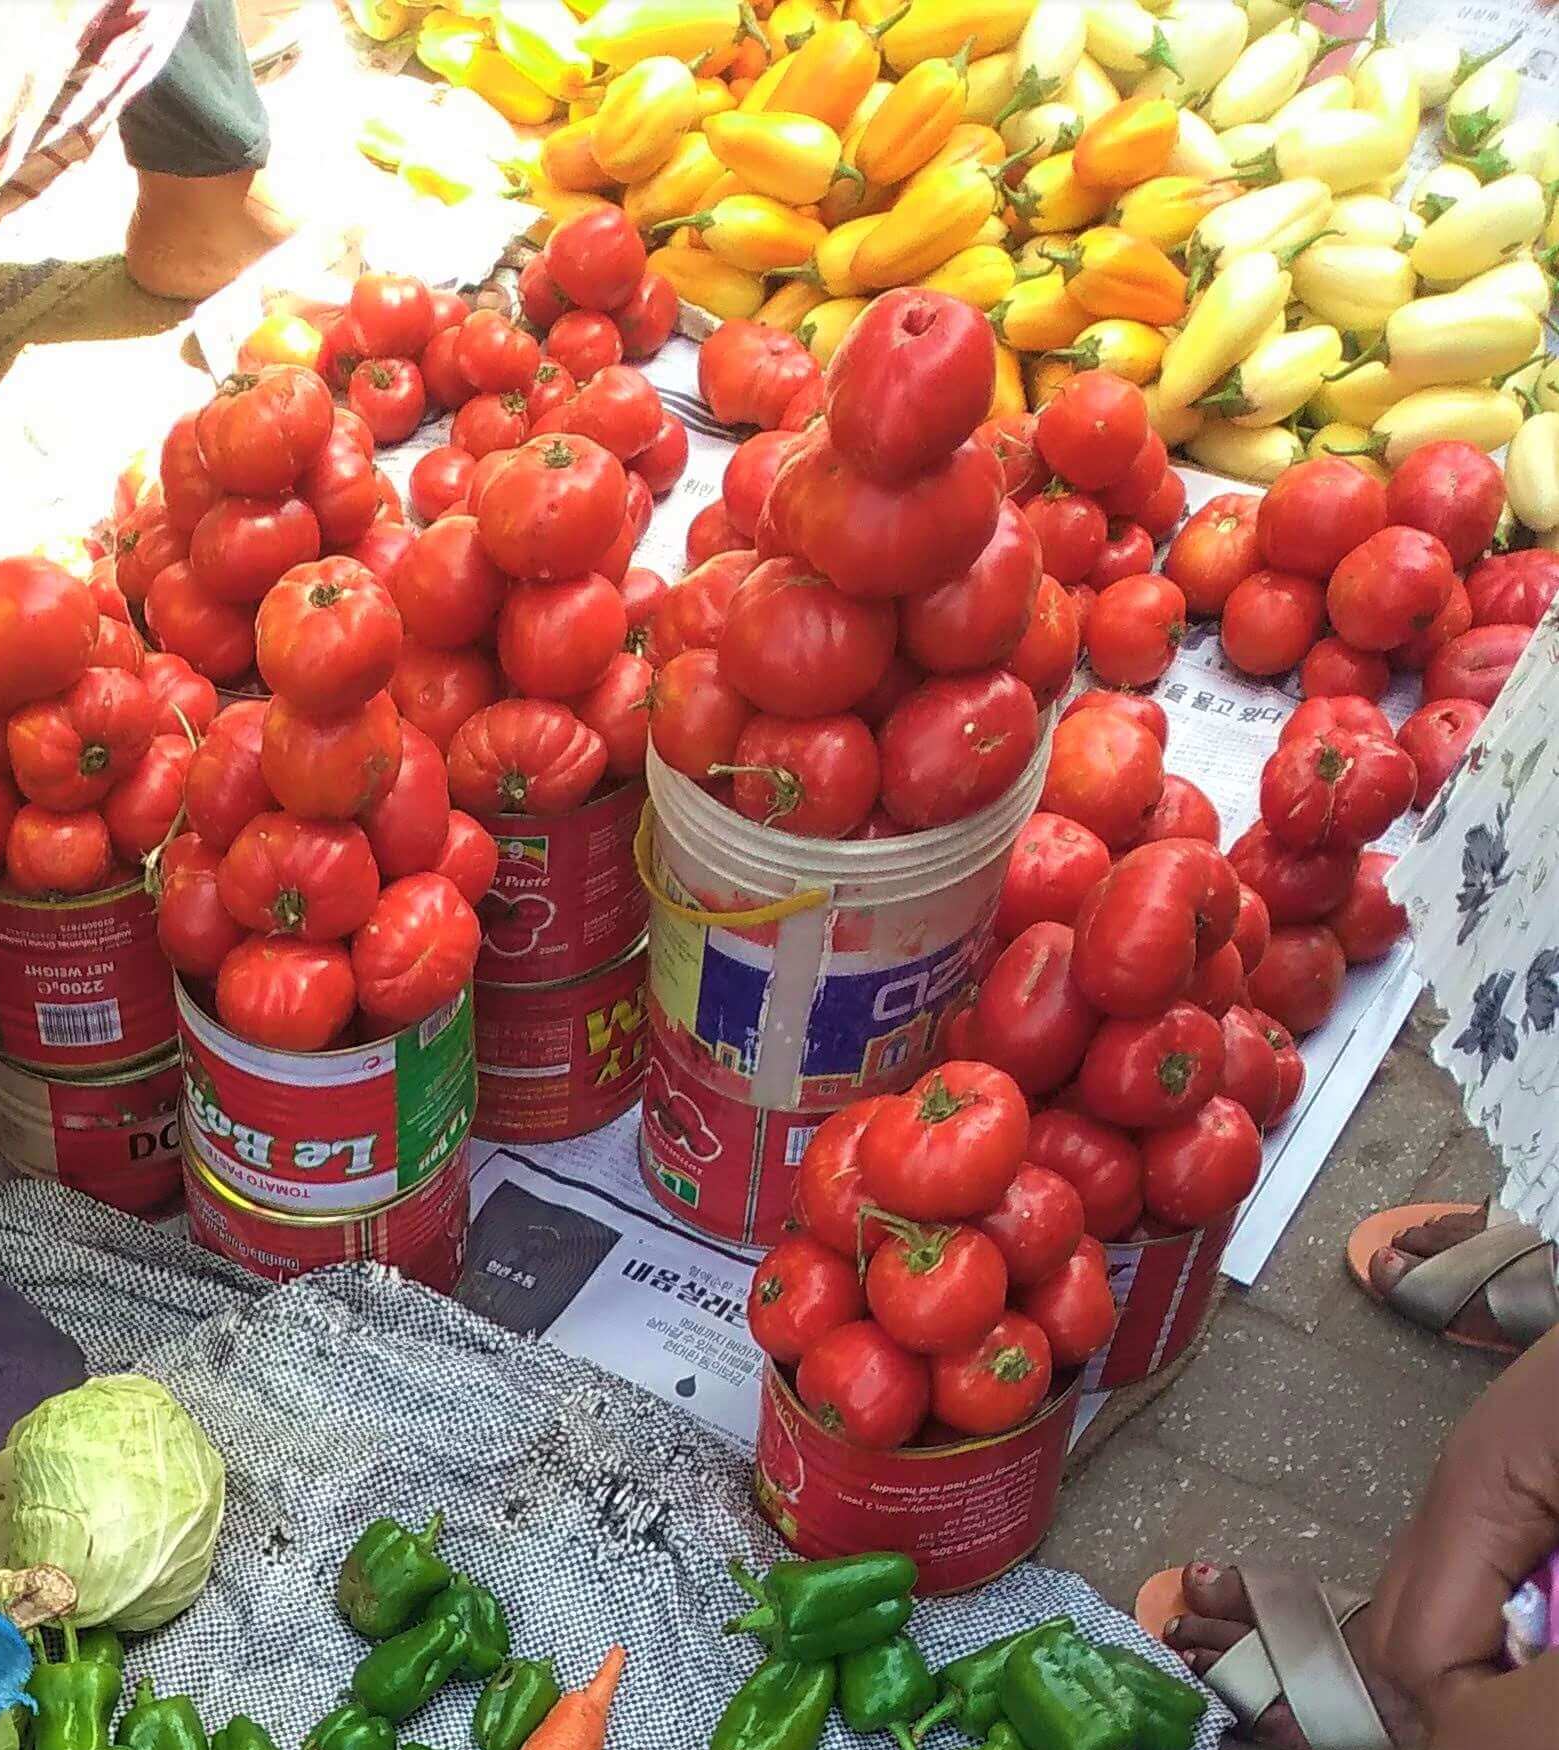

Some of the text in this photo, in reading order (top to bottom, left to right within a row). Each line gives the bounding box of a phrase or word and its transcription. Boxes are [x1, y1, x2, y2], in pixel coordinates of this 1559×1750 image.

[24, 961, 114, 978] NET WEIGHT
[291, 1133, 378, 1173] Le
[205, 1147, 310, 1199] TOMATO PASTE
[869, 1482, 916, 1494] humidity
